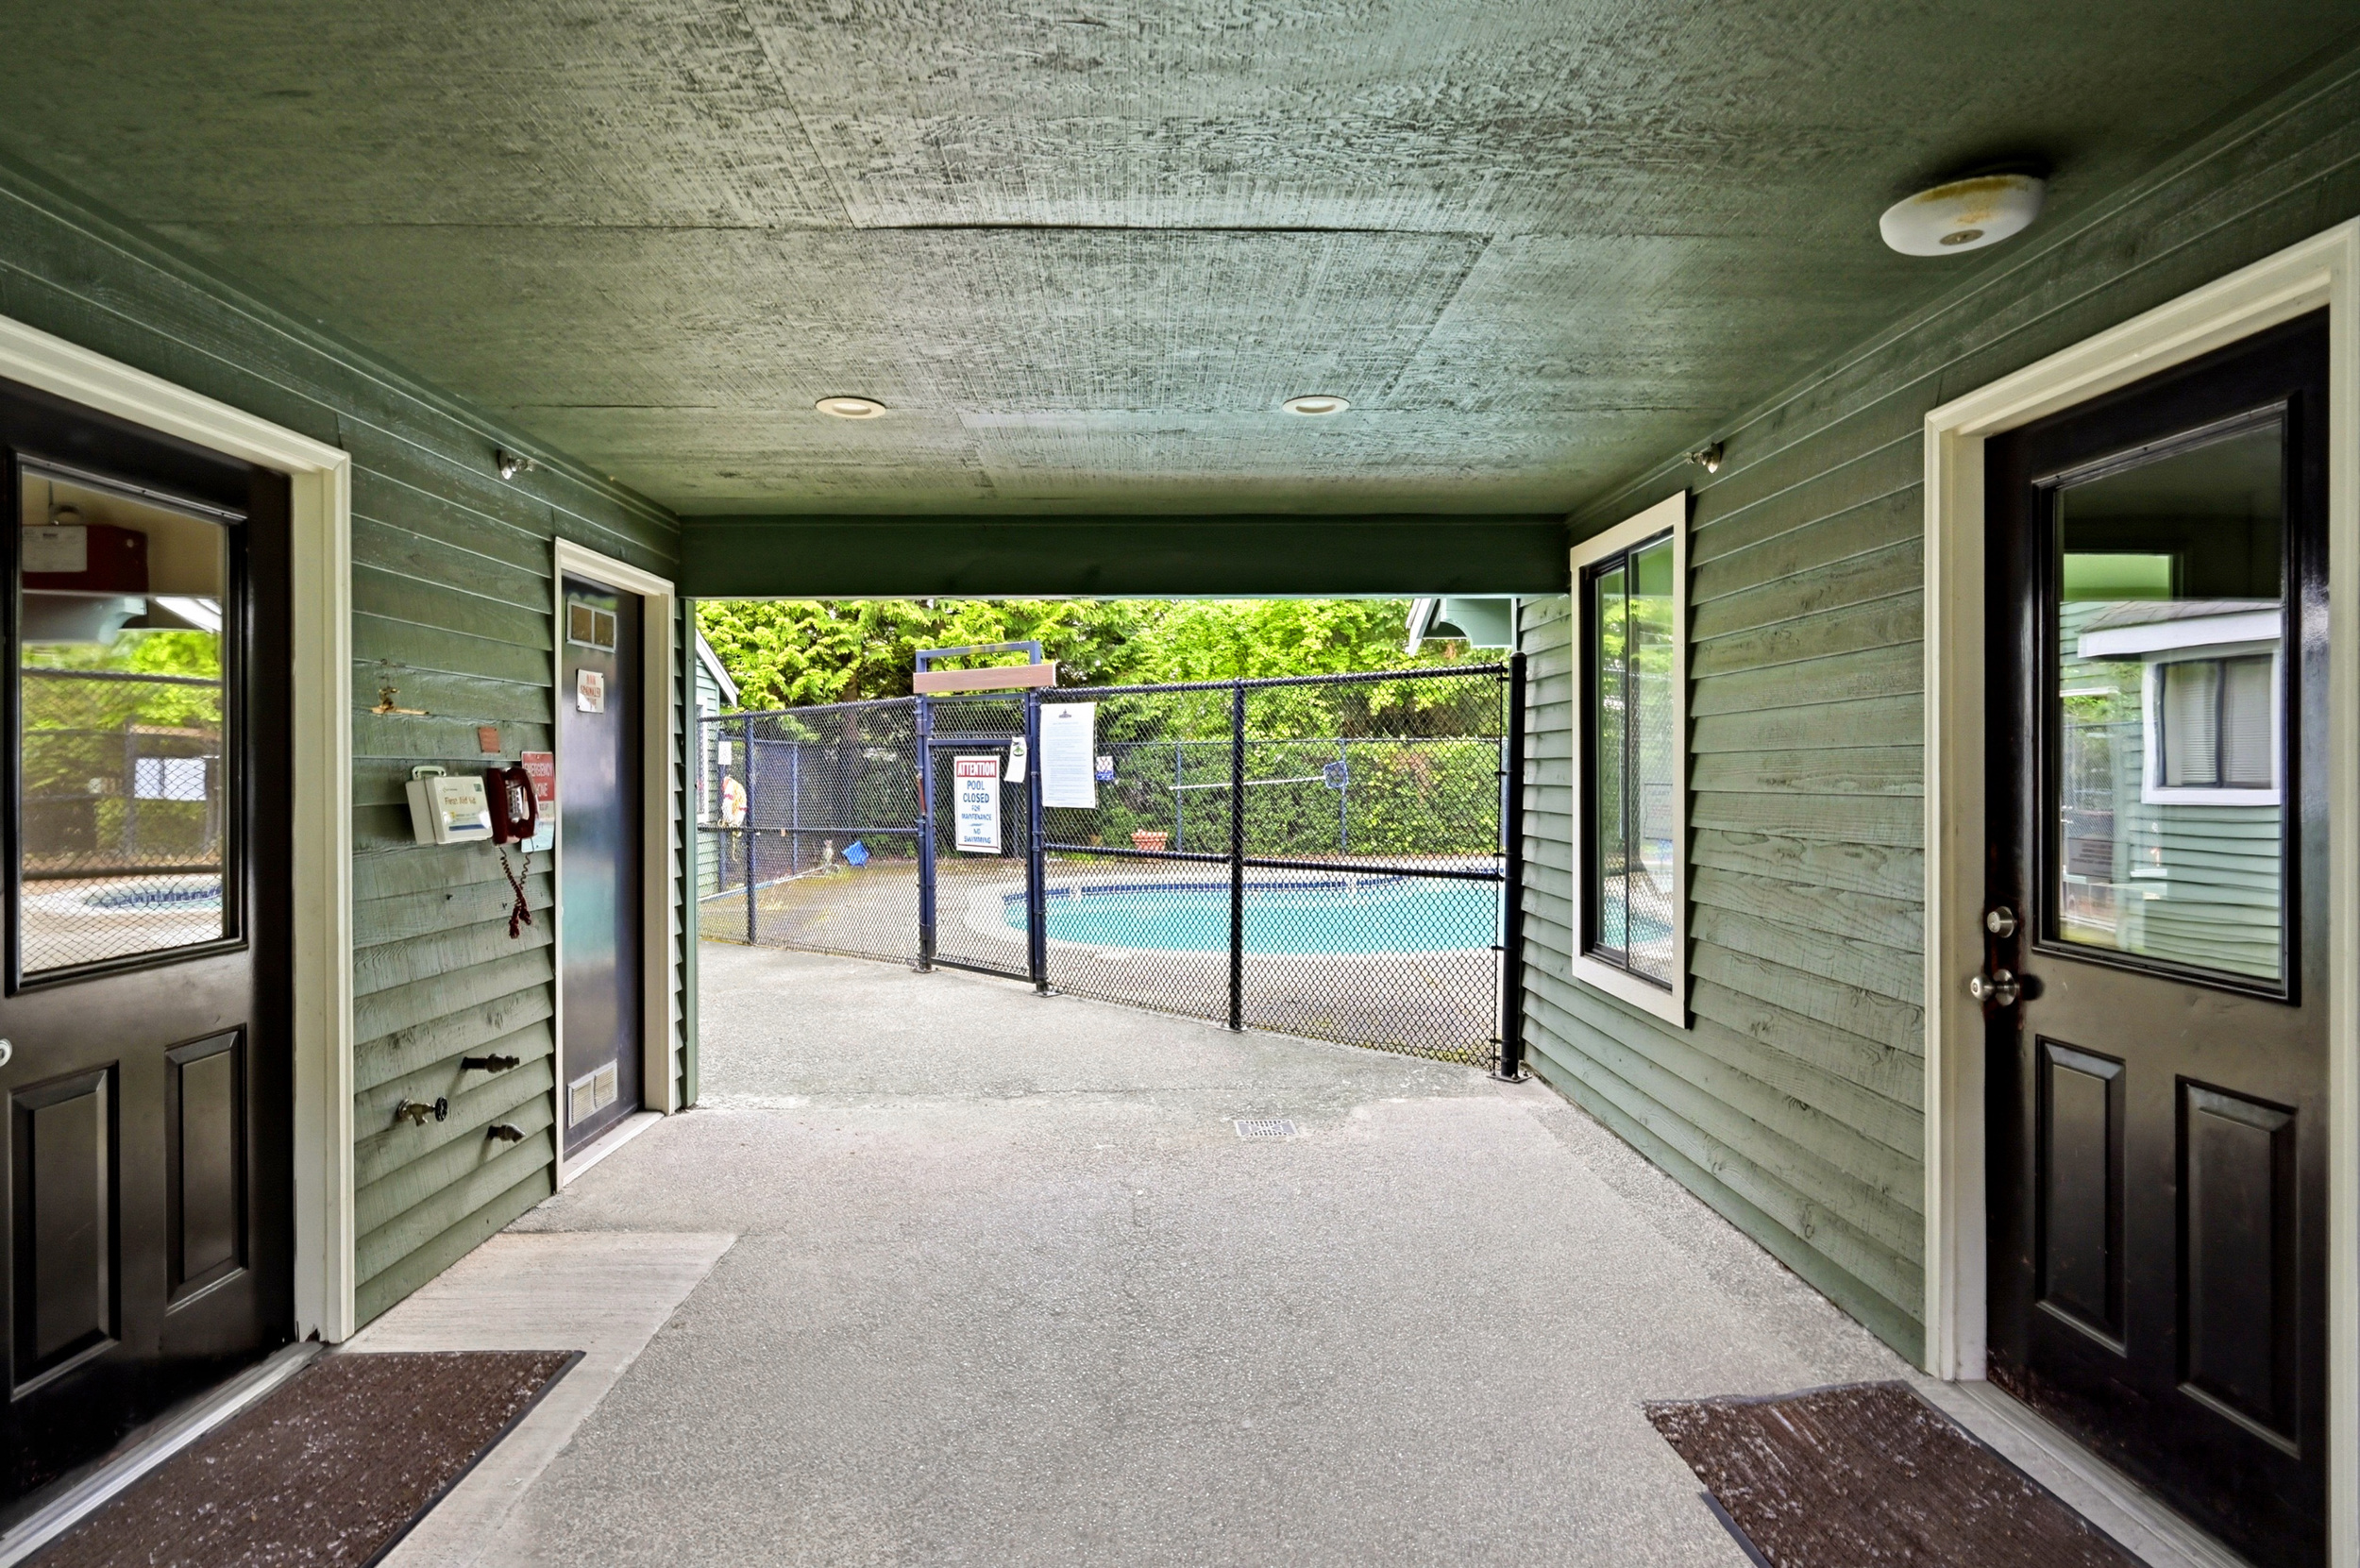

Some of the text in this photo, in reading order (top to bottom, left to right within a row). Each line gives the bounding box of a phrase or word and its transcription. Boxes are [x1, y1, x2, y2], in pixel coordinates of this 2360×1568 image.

[957, 761, 996, 777] ATTENTION
[967, 780, 986, 791] POOL
[963, 792, 990, 803] CLOSED
[961, 813, 992, 821] MAINTENANCE
[964, 835, 991, 844] SWIMMING
